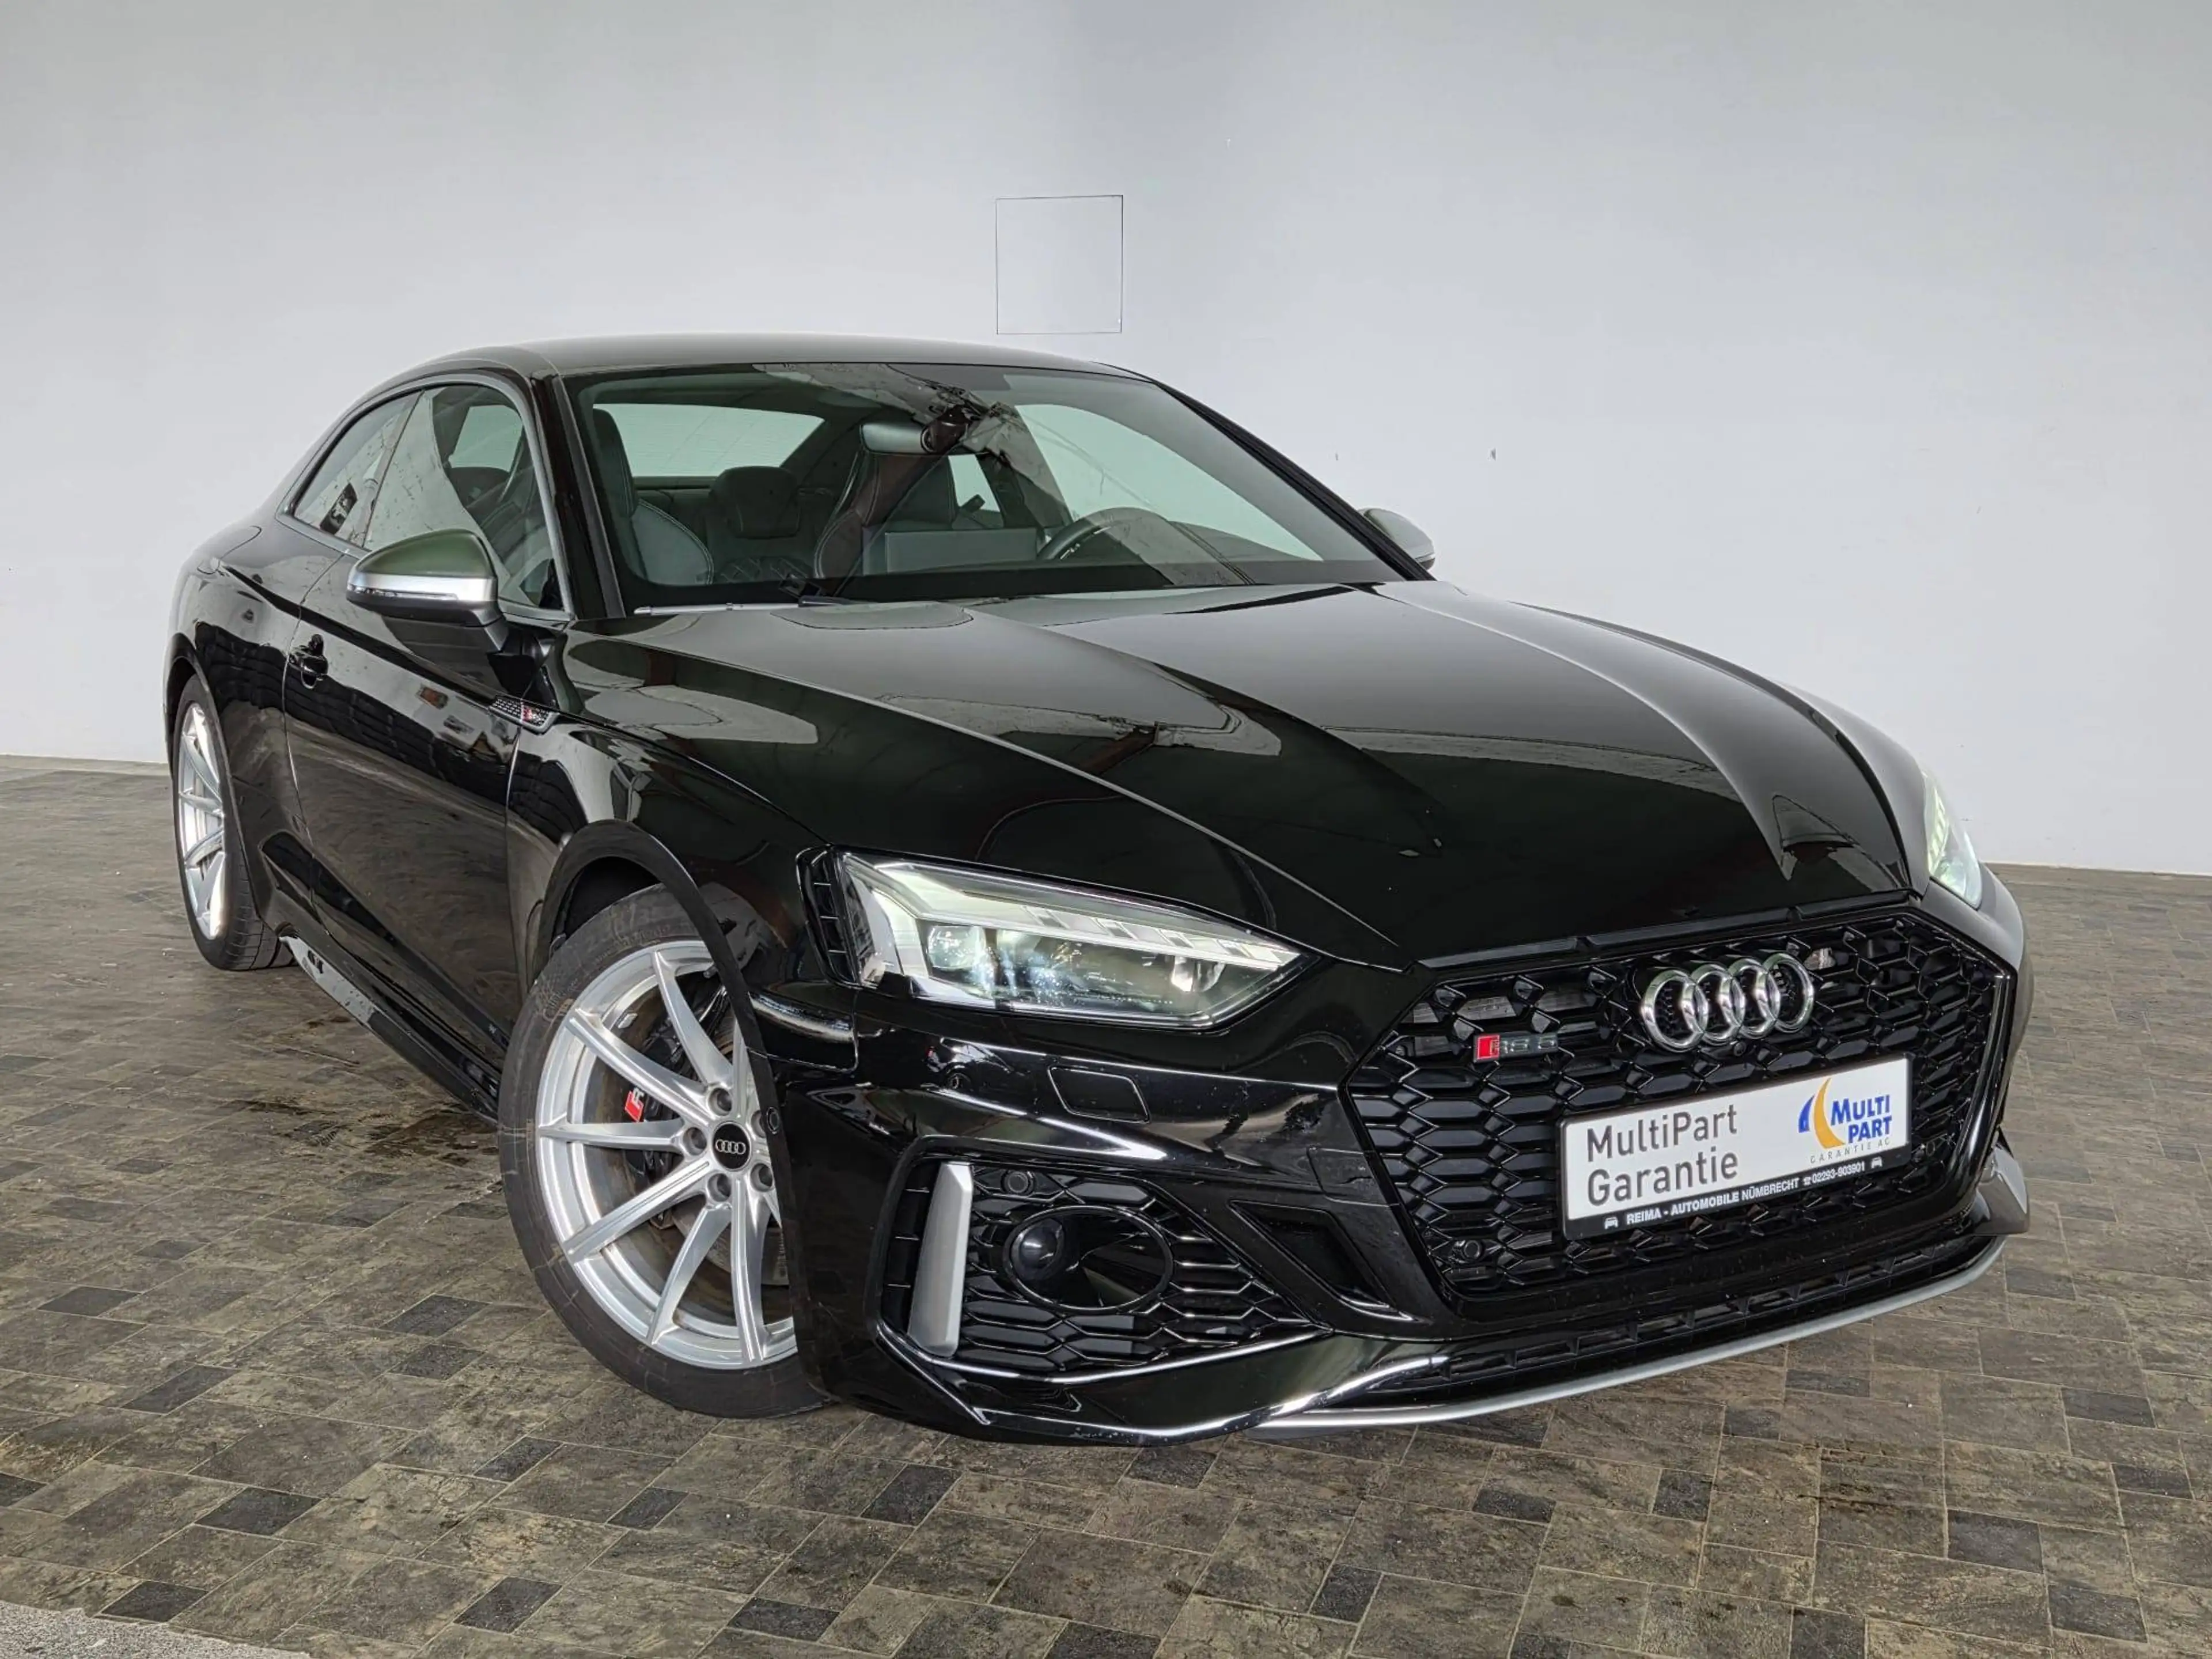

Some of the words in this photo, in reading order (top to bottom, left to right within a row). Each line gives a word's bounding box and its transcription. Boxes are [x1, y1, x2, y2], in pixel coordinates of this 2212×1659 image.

[1587, 1104, 1737, 1162] MultiPart
[1831, 1094, 1890, 1126] MULTI
[1848, 1115, 1892, 1143] PART
[1588, 1146, 1738, 1206] Garantie
[1626, 1207, 1662, 1225] REIMA
[1670, 1191, 1740, 1217] AUTOMOBILE
[1741, 1177, 1800, 1201] NÜMBRECHT
